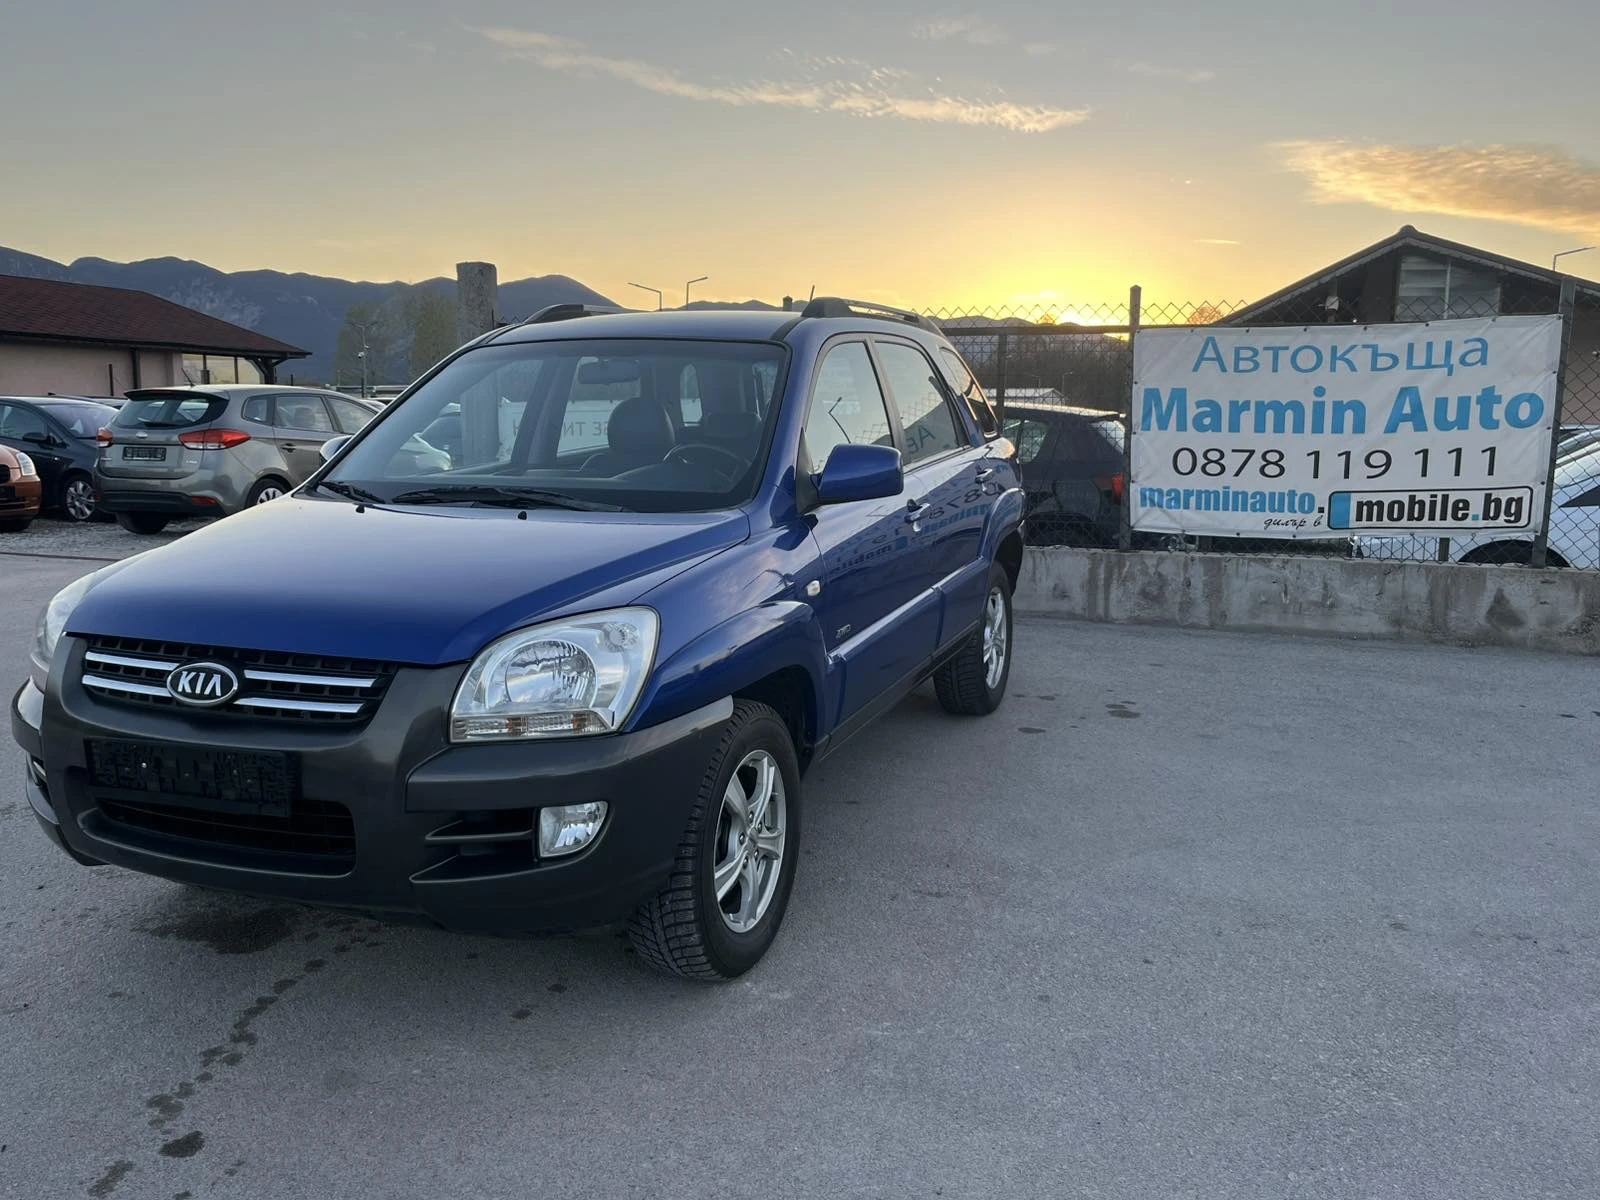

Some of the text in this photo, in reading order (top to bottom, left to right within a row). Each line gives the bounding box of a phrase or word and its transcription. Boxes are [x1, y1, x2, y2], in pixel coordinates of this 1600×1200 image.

[1192, 336, 1488, 376] Автокъща
[1141, 385, 1544, 434] Marmin Auto
[1172, 446, 1497, 479] 0878 119 111
[1355, 493, 1524, 524] mobile.bg
[177, 671, 222, 697] KIA
